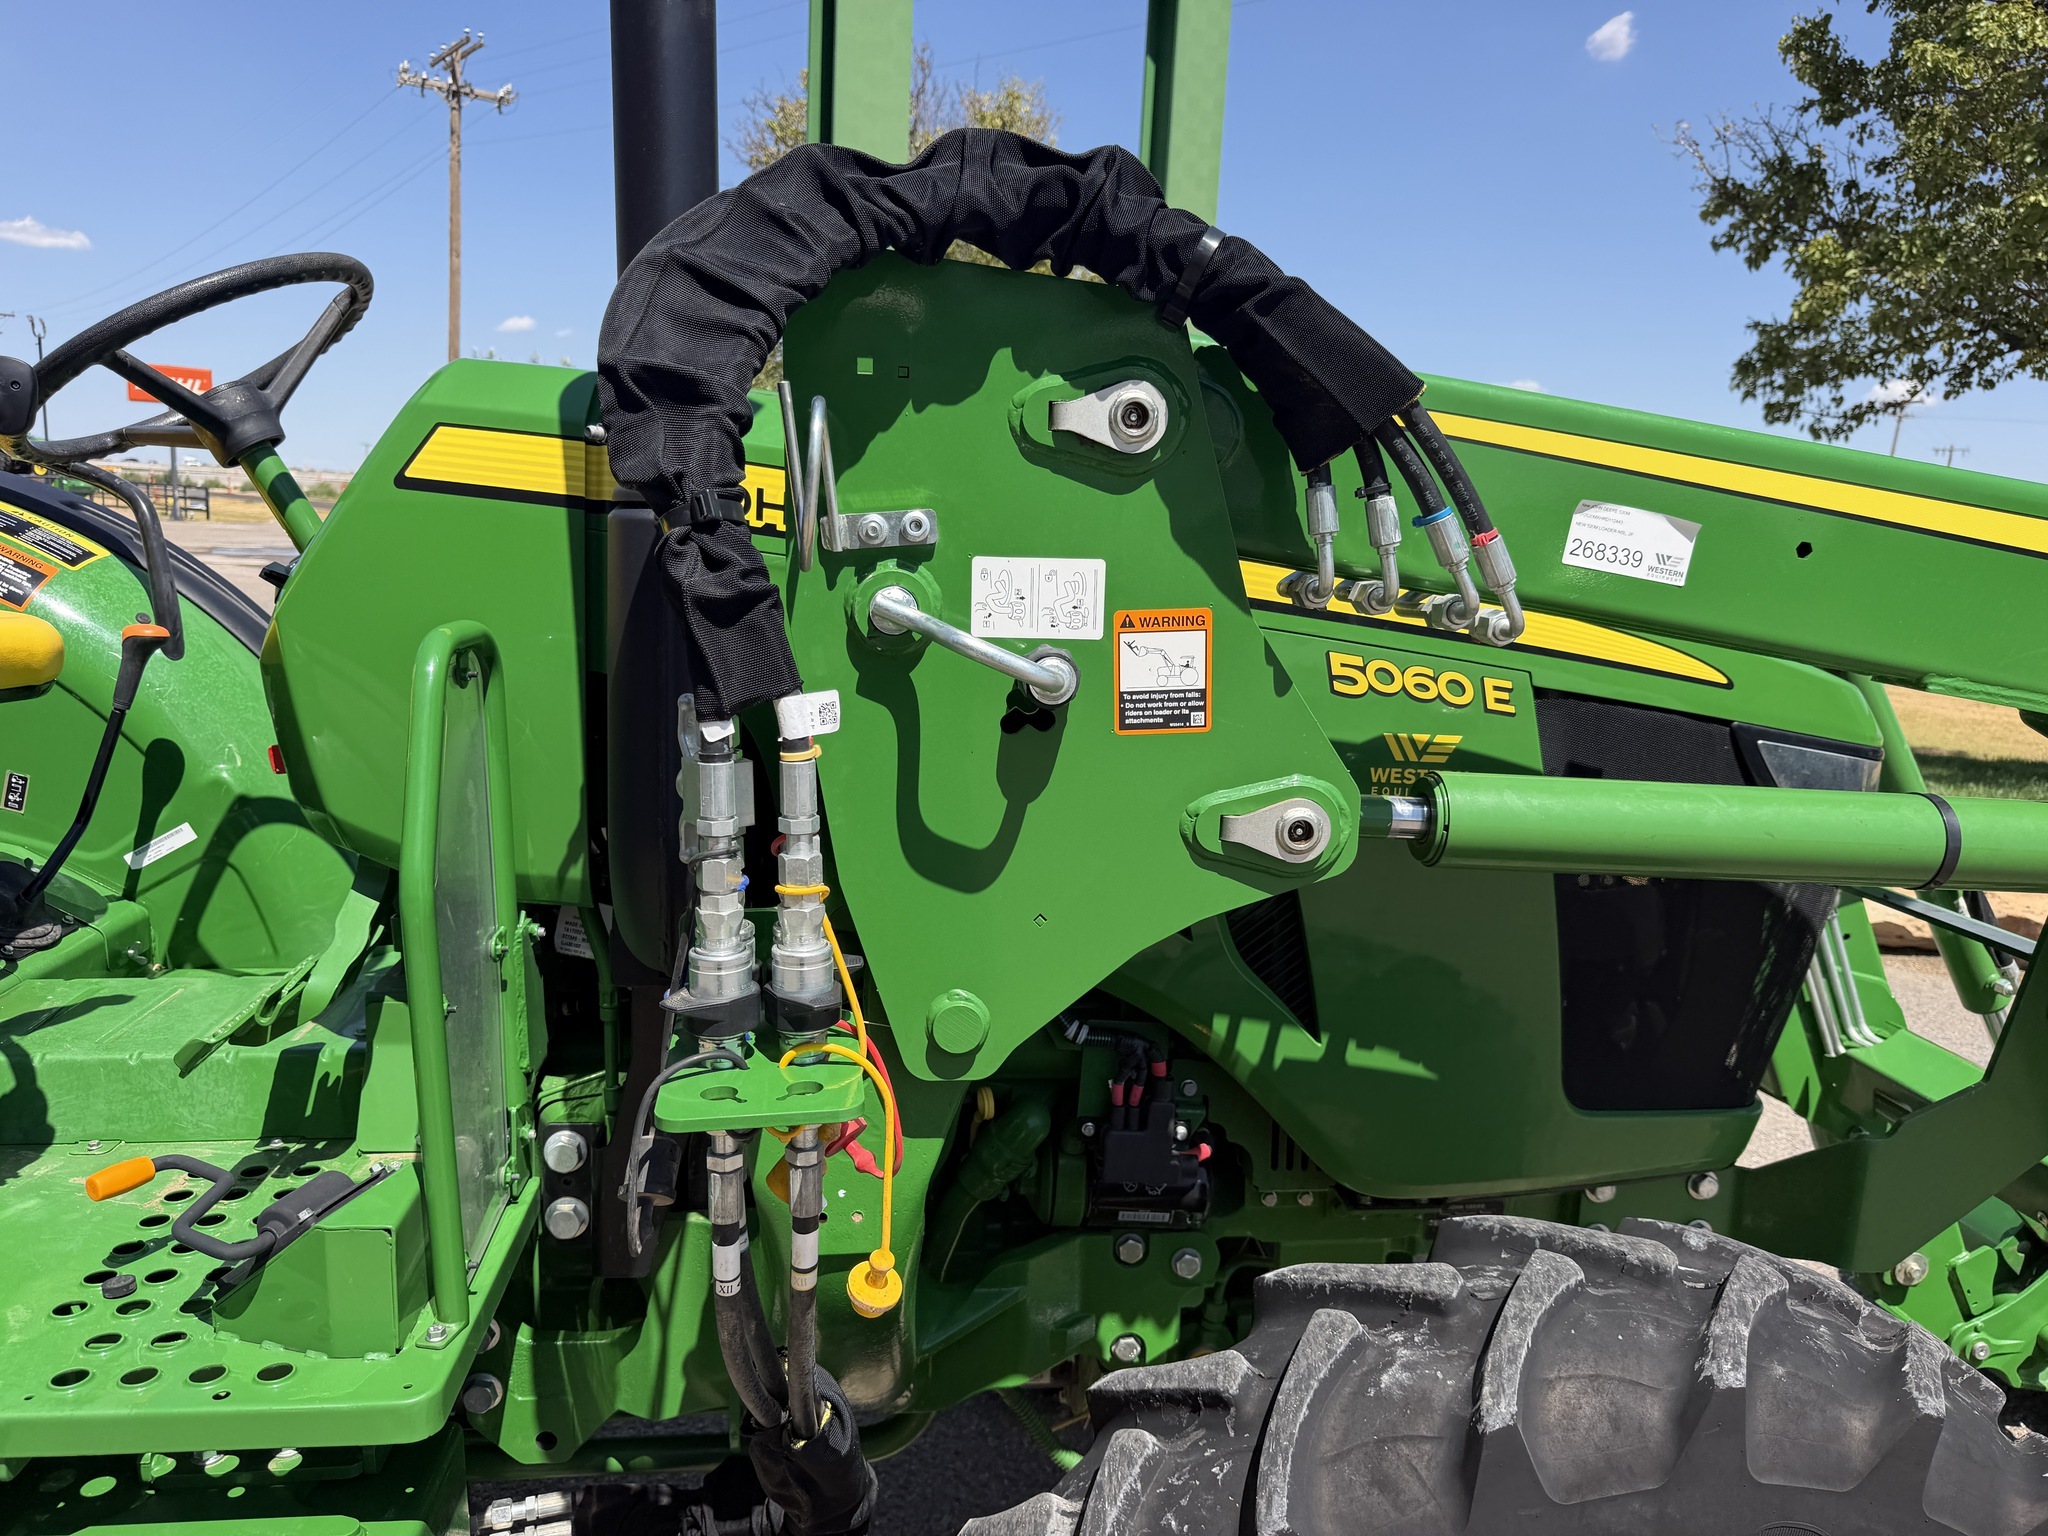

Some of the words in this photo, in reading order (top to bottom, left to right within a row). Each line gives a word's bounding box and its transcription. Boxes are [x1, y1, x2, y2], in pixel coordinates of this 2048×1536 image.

[1424, 490, 1436, 508] MAX
[28, 516, 74, 538] CAUTION
[1568, 538, 1644, 568] 268339
[1646, 572, 1682, 583] EQUIPMENT
[1648, 564, 1684, 578] WESTERN
[1139, 614, 1206, 628] WARNING
[1325, 650, 1475, 708] 5060
[1480, 676, 1516, 717] E
[1370, 767, 1429, 785] WEST
[719, 1285, 733, 1294] XII
